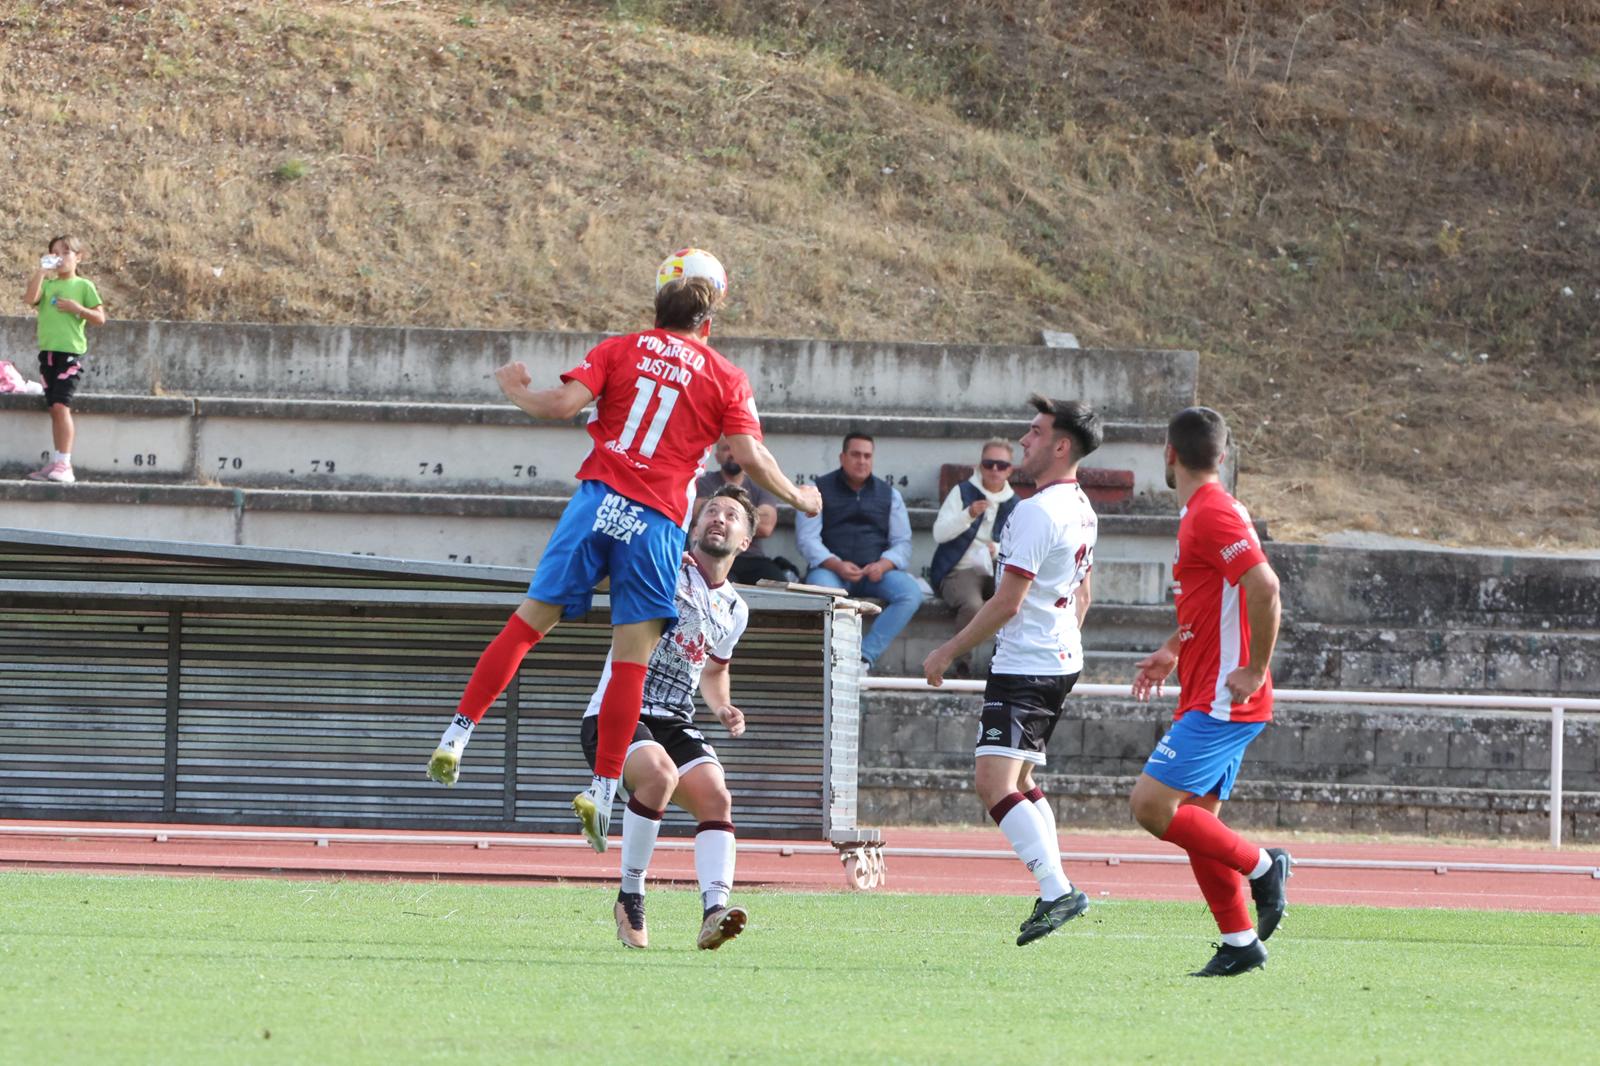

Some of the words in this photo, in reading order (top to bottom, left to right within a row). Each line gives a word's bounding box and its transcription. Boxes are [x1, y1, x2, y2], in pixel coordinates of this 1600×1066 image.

[636, 356, 692, 387] JUSTINO
[618, 376, 679, 459] 11
[218, 457, 242, 470] 70
[418, 463, 443, 476] 74
[513, 465, 537, 478] 76
[602, 493, 629, 511] MY
[592, 518, 632, 544] PIZZA
